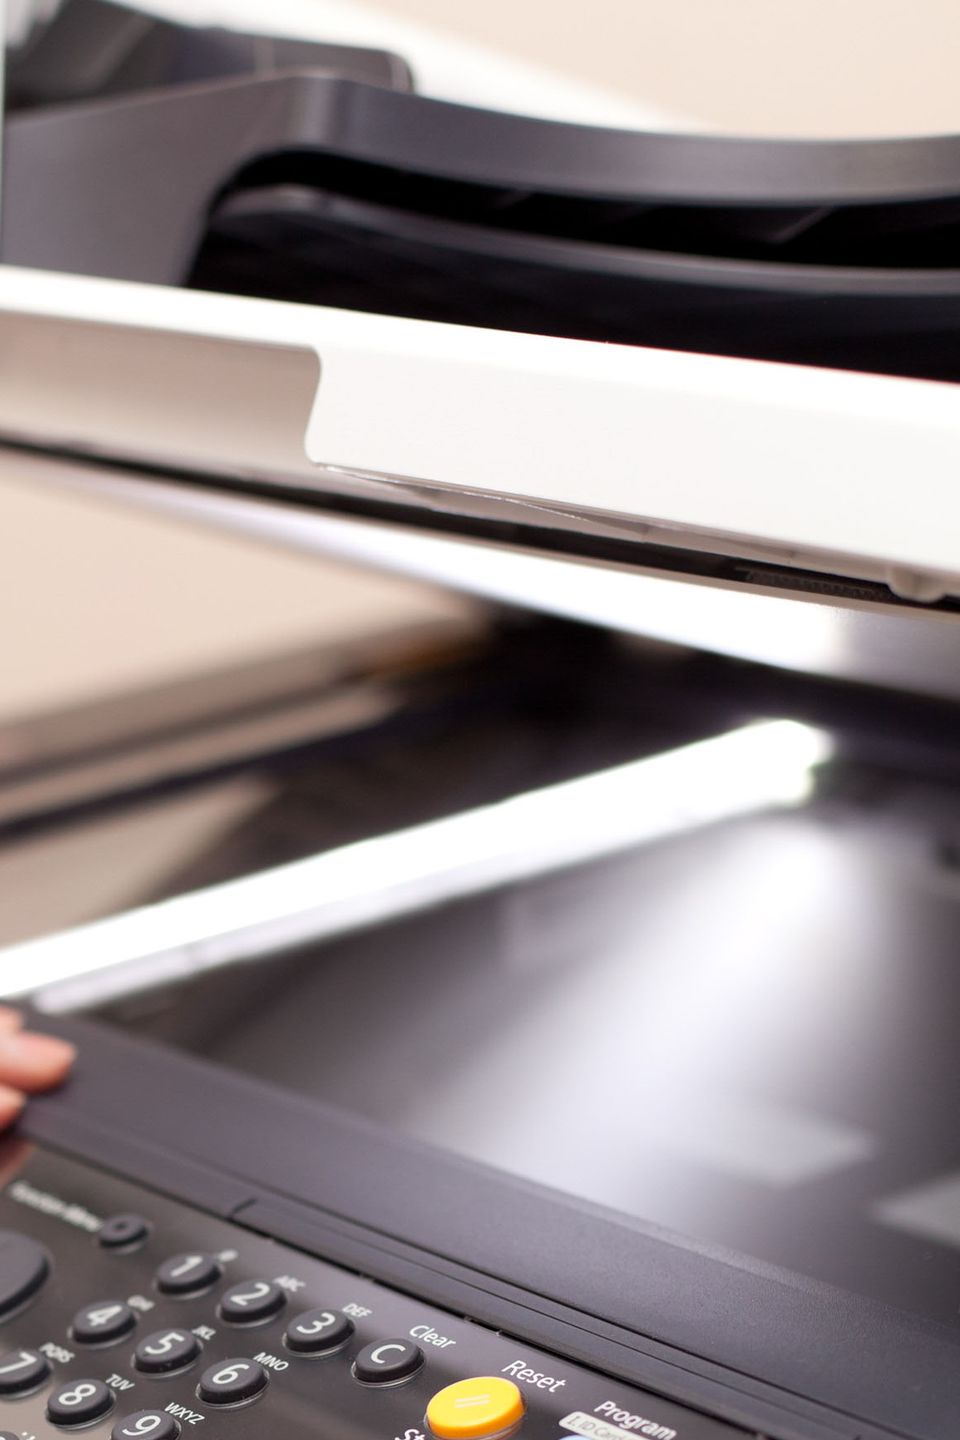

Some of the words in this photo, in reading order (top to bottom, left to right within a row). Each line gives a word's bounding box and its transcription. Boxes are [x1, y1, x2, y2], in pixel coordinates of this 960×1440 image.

[171, 1255, 203, 1277] 1
[230, 1282, 271, 1306] 2
[87, 1304, 123, 1327] 4
[342, 1302, 373, 1318] DEF
[296, 1312, 337, 1334] 3
[144, 1332, 185, 1355] 5
[409, 1324, 457, 1349] Clear
[252, 1352, 290, 1371] MNO
[370, 1344, 407, 1364] C
[105, 1373, 135, 1391] TUV
[212, 1363, 250, 1385] 6
[501, 1360, 567, 1393] Reset
[58, 1383, 96, 1406] 8
[164, 1402, 206, 1425] WXYZ
[122, 1415, 161, 1436] 9
